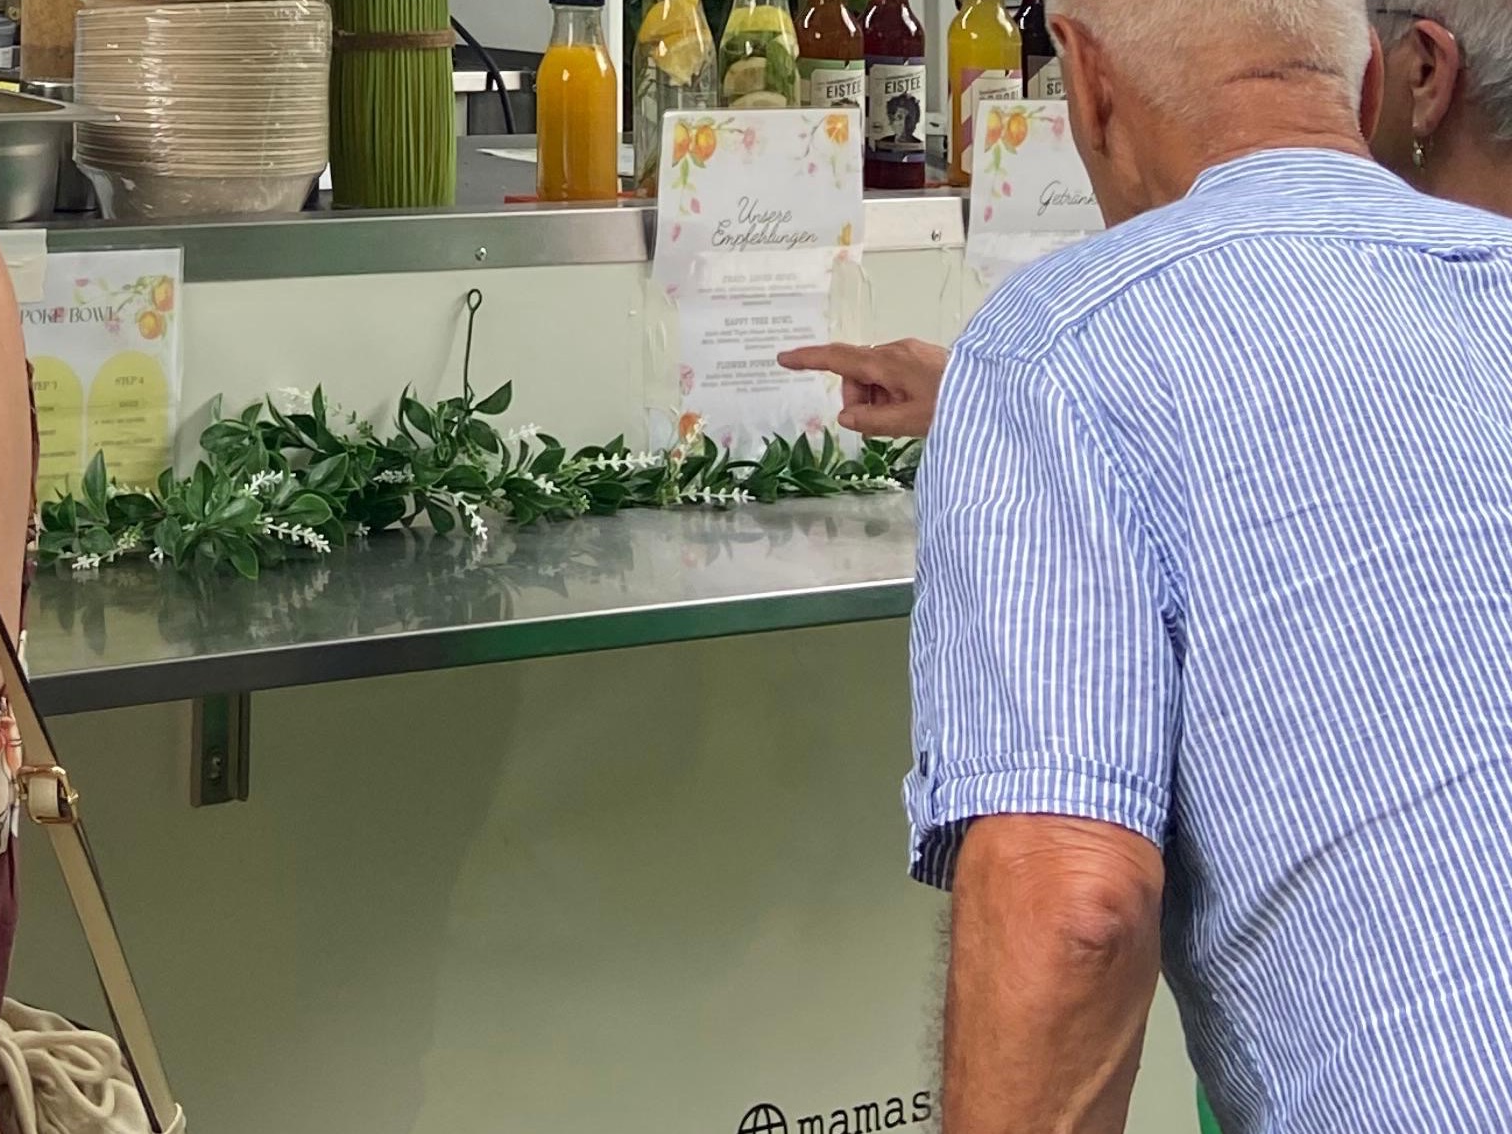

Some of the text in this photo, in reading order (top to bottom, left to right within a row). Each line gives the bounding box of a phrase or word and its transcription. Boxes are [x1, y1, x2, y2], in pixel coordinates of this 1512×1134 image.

[884, 76, 921, 95] EISTEE
[737, 195, 793, 224] Unsere
[711, 219, 819, 252] Empfehlungen
